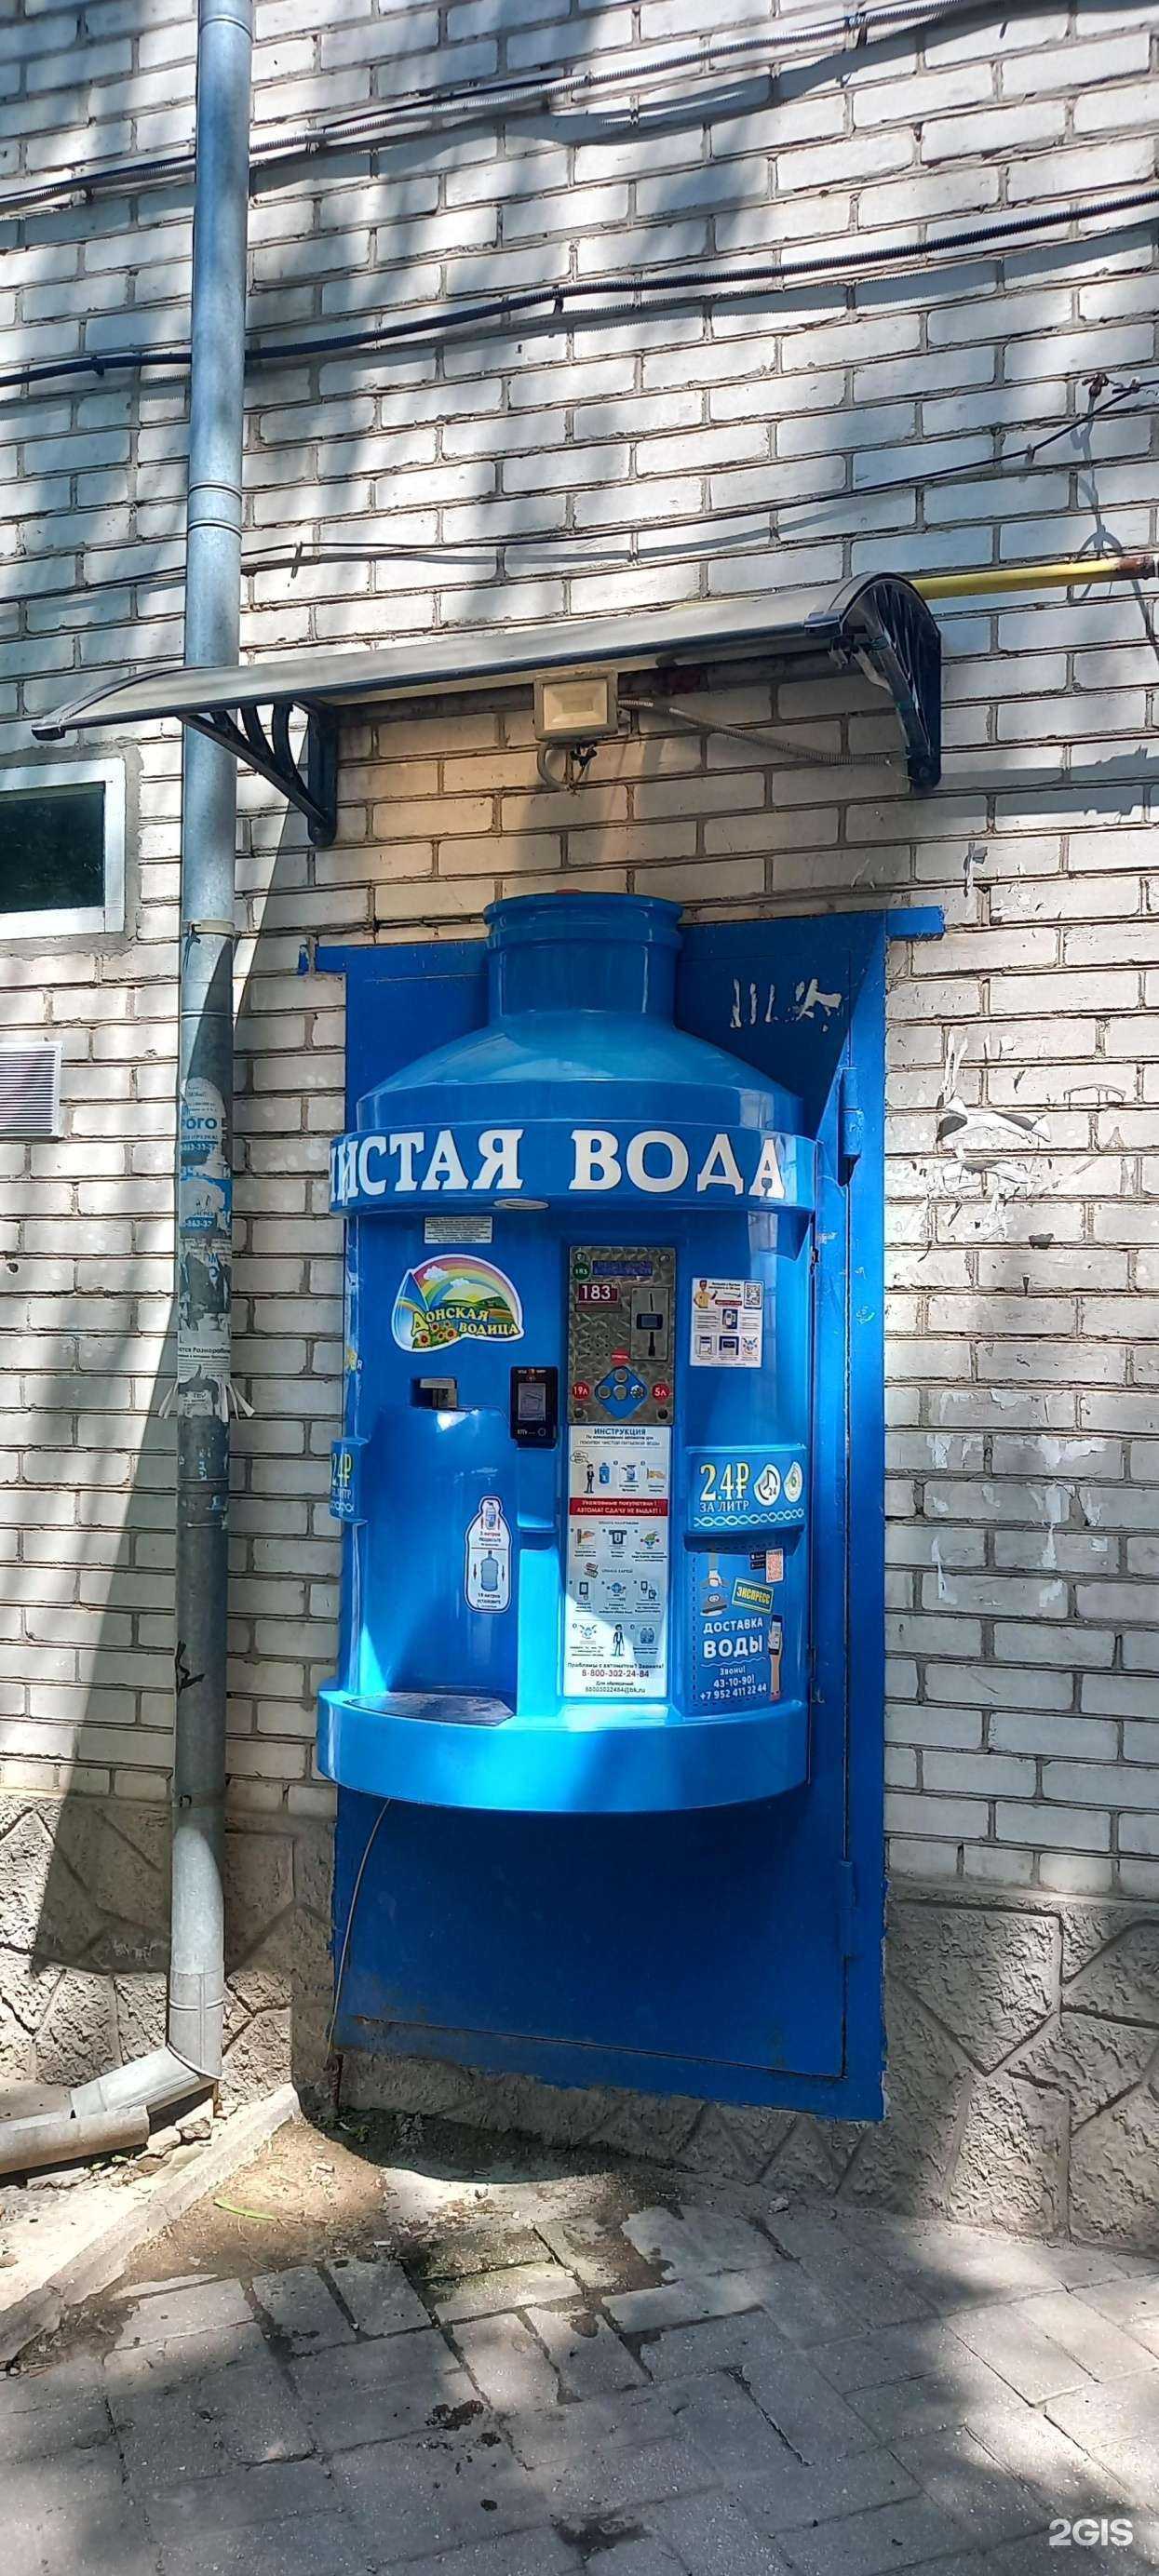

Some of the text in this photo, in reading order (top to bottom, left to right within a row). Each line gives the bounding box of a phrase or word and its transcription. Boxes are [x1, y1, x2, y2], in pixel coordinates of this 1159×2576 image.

[331, 1129, 786, 1201] ИСТАЯ ВОДА
[581, 1284, 611, 1300] 183
[411, 1307, 490, 1336] ДОНСКАЯ
[459, 1322, 519, 1335] ВОДИЦА
[594, 1428, 646, 1436] ИНСТРУКЦИЯ
[768, 1487, 777, 1496] 24
[700, 1500, 749, 1513] ЗА ЛИТР
[736, 1586, 771, 1604] ЭКСПРЕСС
[703, 1617, 763, 1634] ДОСТАВКА
[703, 1635, 762, 1658] ВОДЫ
[720, 1666, 746, 1675] Звони!
[713, 1674, 755, 1688] 43-10-90!
[700, 1683, 767, 1700] +7 952 411 22 44
